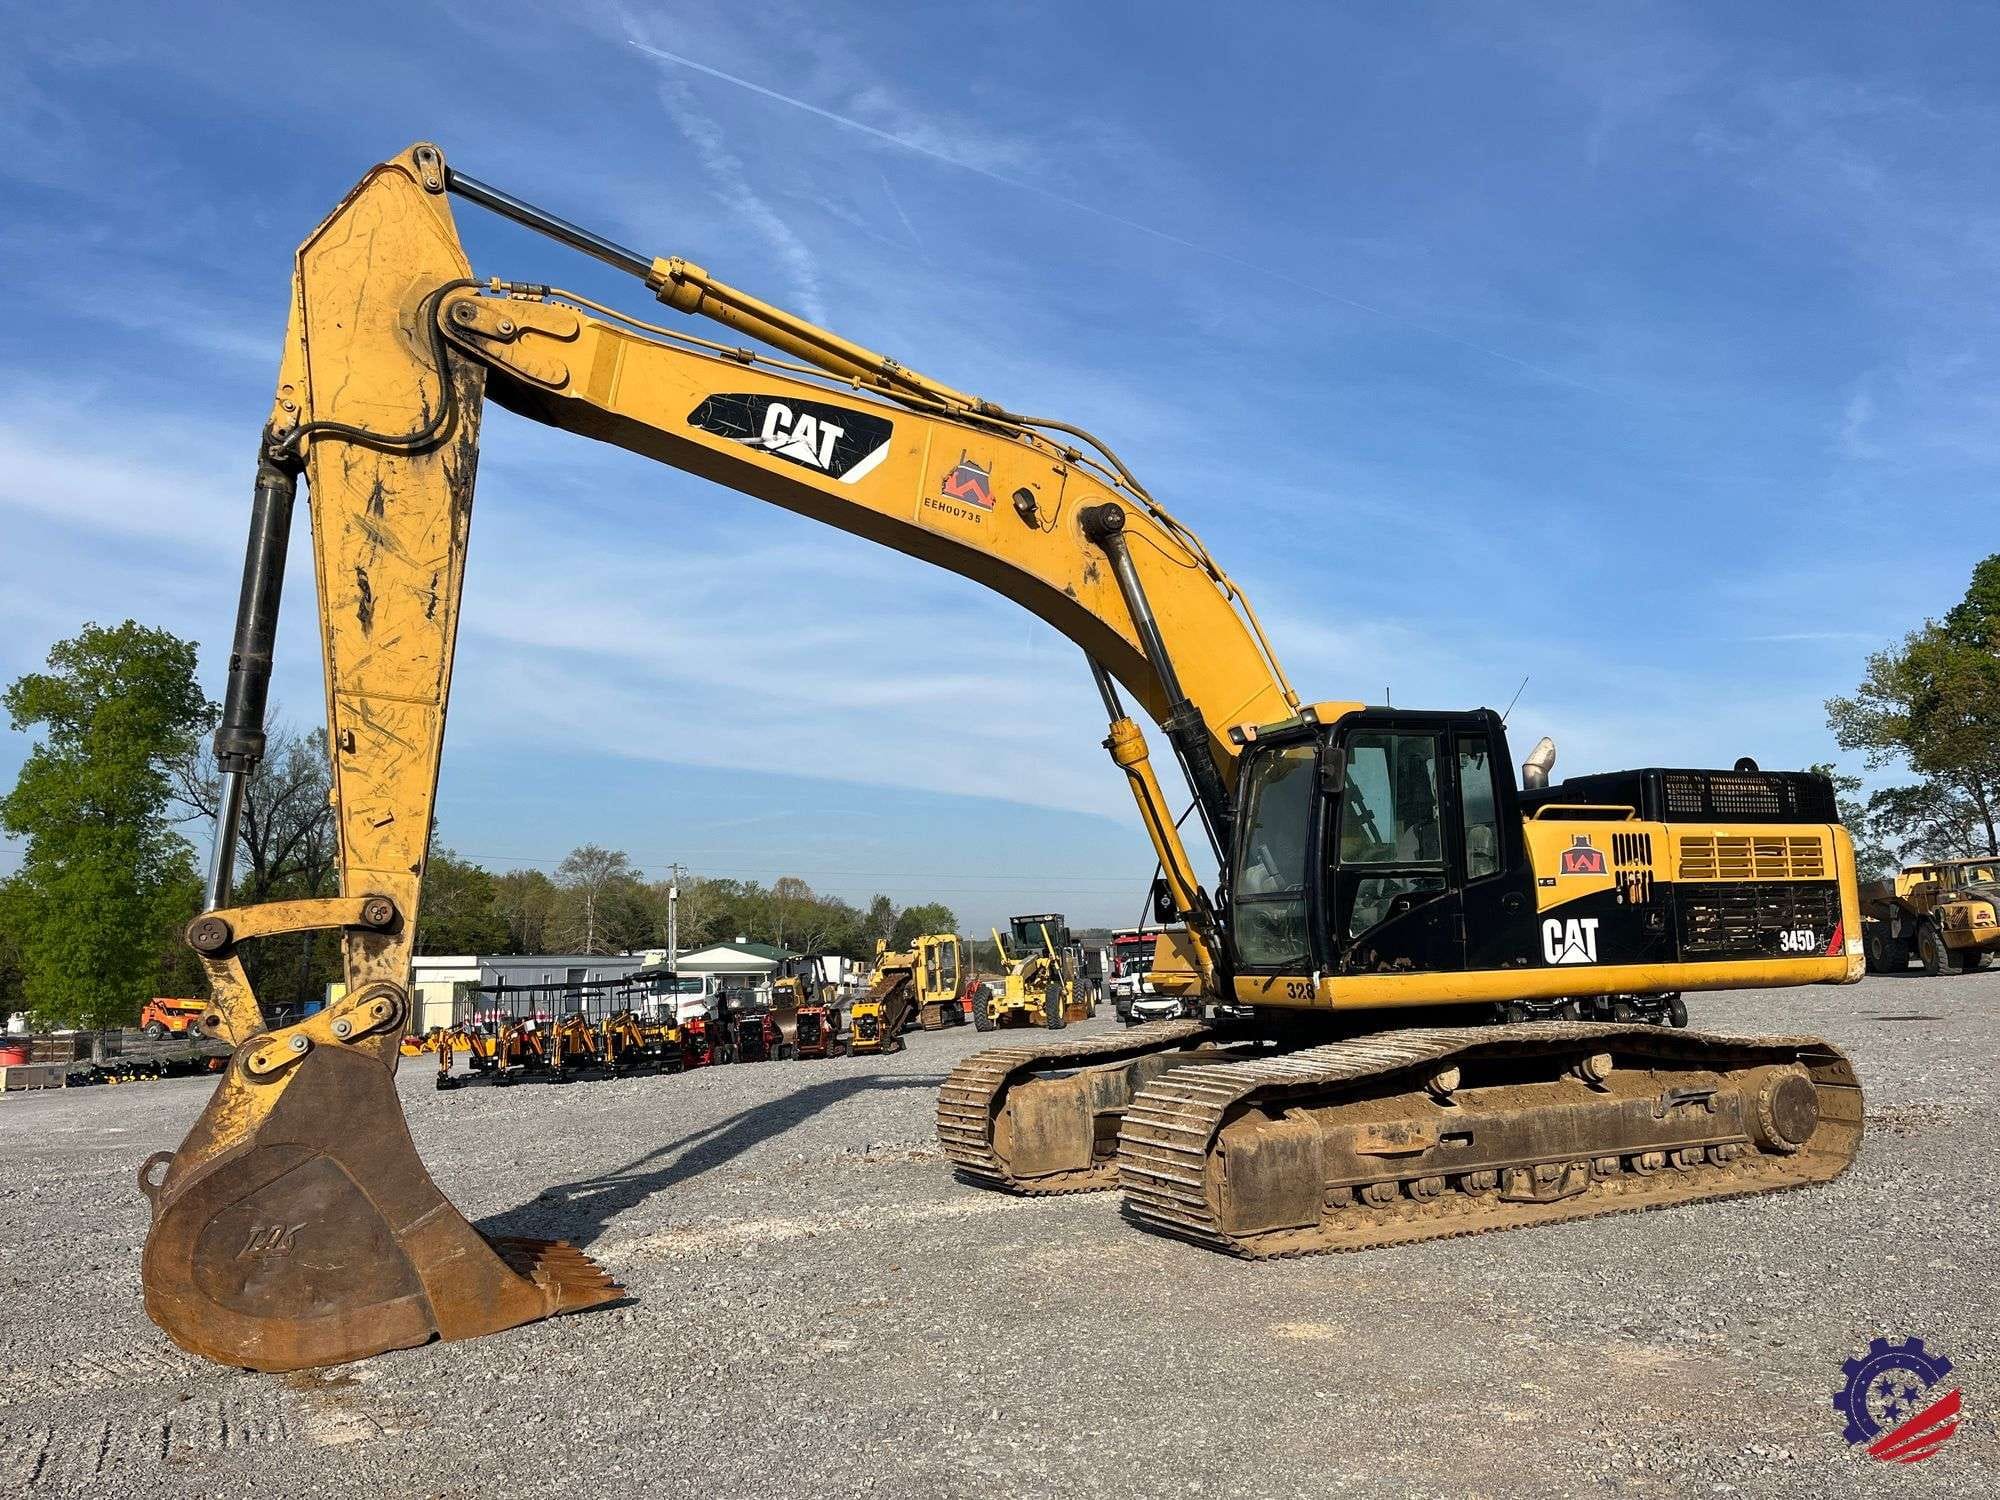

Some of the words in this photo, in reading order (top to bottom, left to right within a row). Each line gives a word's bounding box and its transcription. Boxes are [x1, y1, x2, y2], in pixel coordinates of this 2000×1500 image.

[761, 402, 844, 470] CAT
[924, 497, 981, 524] EEH00735
[1542, 918, 1599, 964] CAT
[1780, 930, 1815, 952] 345D
[1287, 982, 1315, 1000] 328
